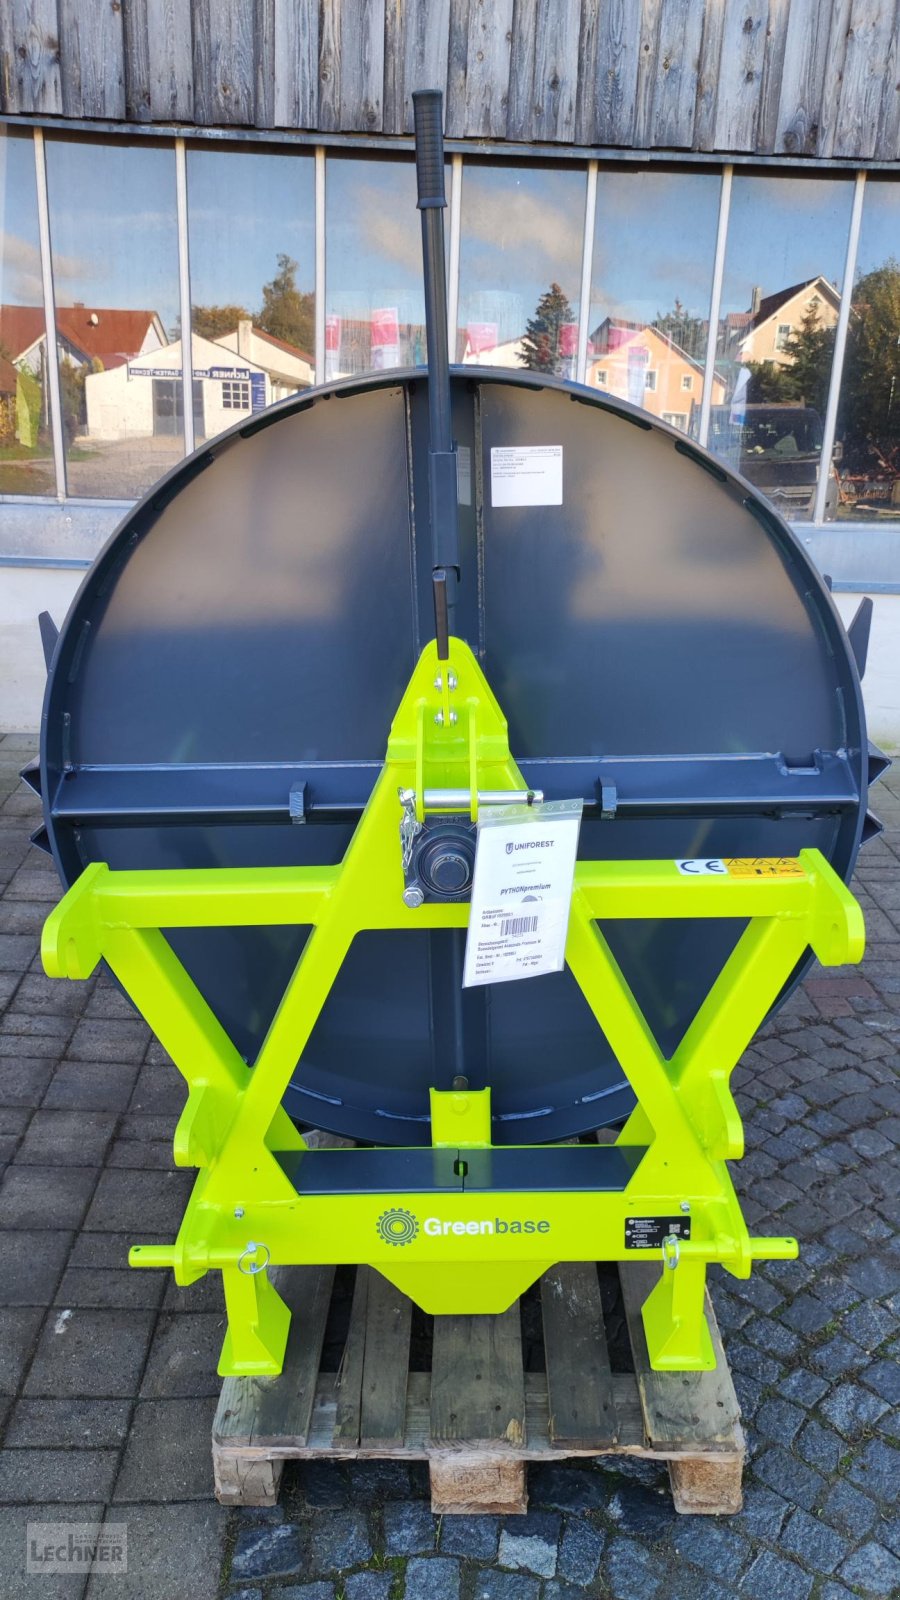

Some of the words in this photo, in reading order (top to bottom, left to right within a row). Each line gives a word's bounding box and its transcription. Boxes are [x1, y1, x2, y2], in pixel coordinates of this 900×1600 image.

[514, 840, 555, 851] UNIFOREST
[500, 884, 551, 896] PYTHONpremium
[423, 1217, 550, 1236] Greenbase
